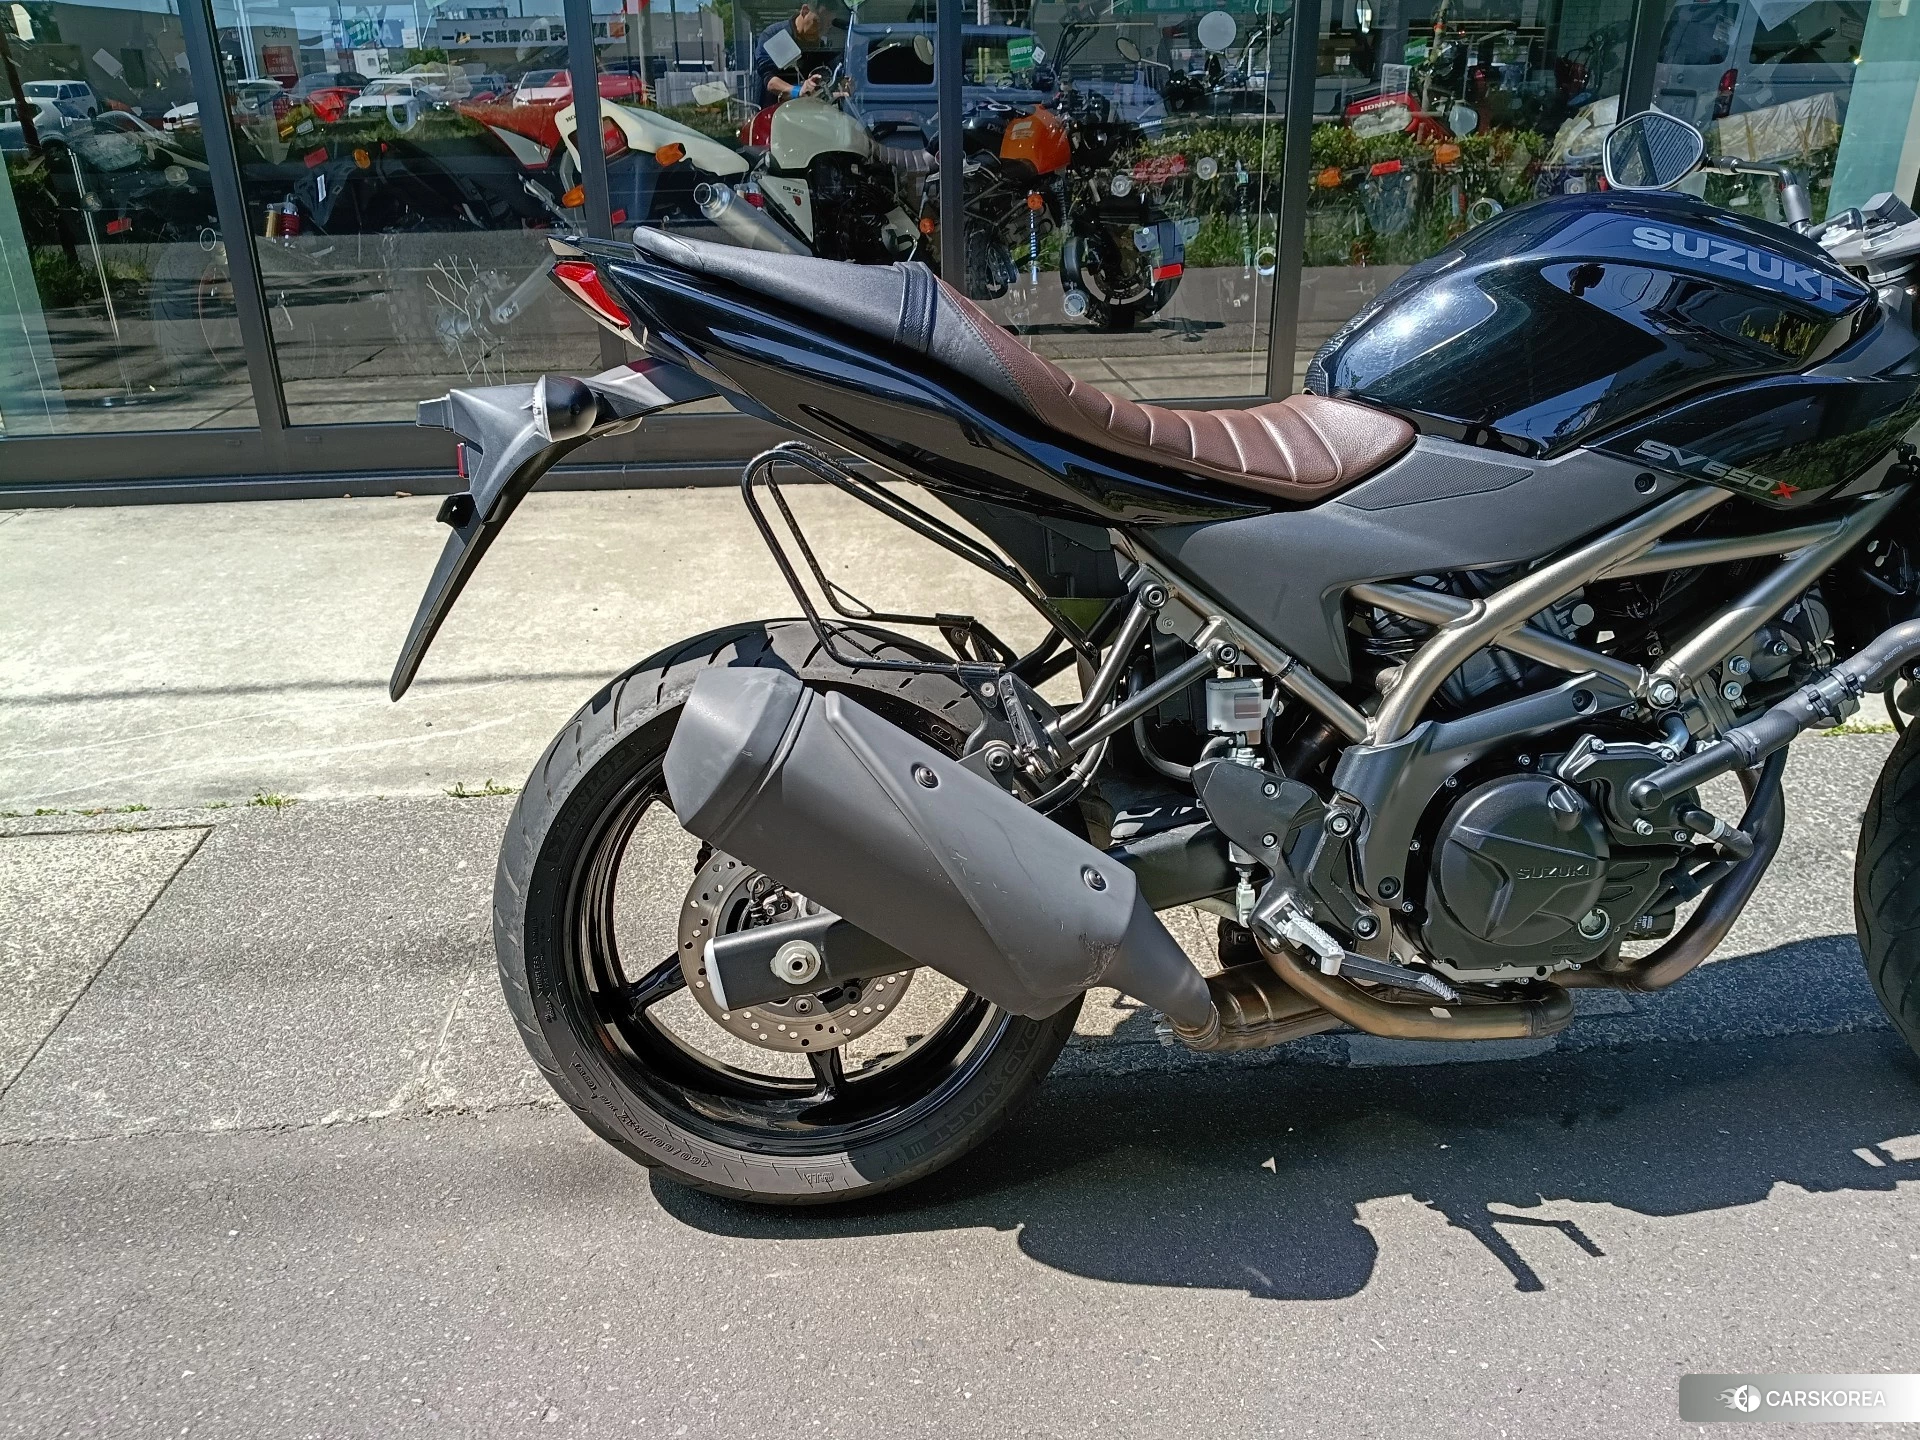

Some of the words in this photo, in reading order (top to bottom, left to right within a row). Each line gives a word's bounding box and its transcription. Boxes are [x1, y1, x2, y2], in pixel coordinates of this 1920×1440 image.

[1360, 100, 1396, 112] HONDA
[1632, 226, 1833, 301] SUZUKI
[1516, 864, 1590, 880] SUZUKI
